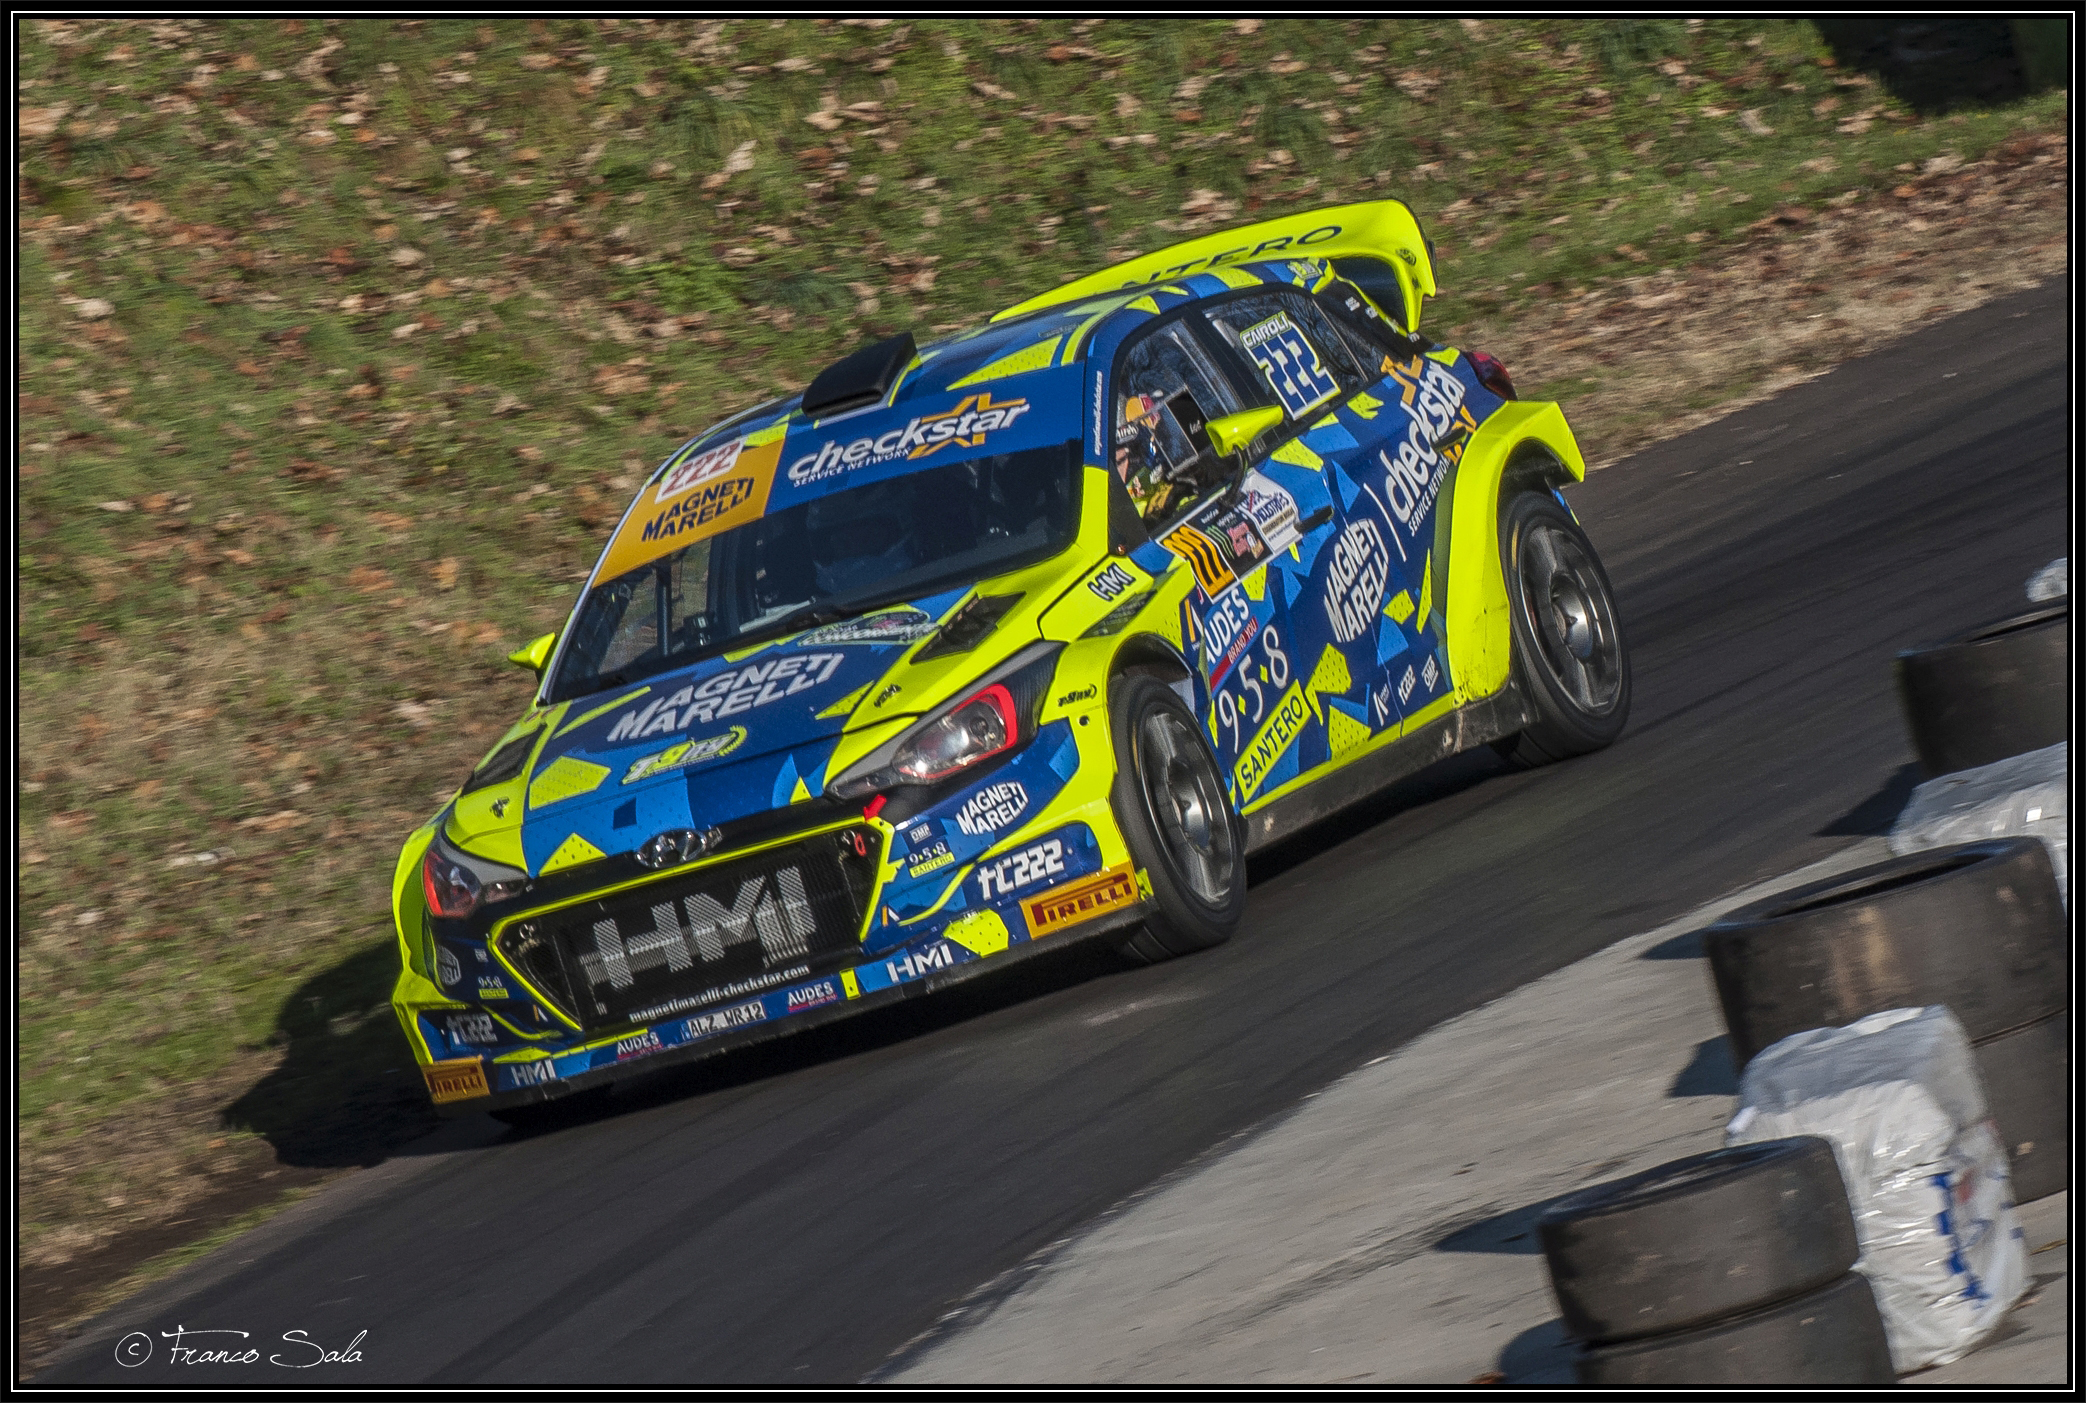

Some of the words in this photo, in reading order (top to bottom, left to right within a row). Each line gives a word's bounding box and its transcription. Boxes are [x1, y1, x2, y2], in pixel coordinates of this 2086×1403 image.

[1242, 315, 1289, 348] CAIROLI
[1249, 323, 1339, 417] 222
[661, 440, 741, 498] 222
[787, 403, 1030, 481] checkstar
[1380, 360, 1466, 524] checkstar
[642, 478, 755, 528] MAGNETI
[793, 464, 844, 488] SERVICE
[641, 488, 753, 542] MARELLI
[1408, 491, 1432, 537] SERVICE
[1087, 562, 1136, 602] HMI
[1162, 526, 1236, 597] 222
[1325, 518, 1389, 618] MAGNETI
[1324, 550, 1389, 643] MARELLI
[1205, 588, 1249, 665] AUDES
[1226, 632, 1248, 664] BRAND
[1244, 616, 1259, 641] YOU
[607, 672, 842, 742] MARELLI
[612, 653, 845, 722] MAGNETI
[1241, 695, 1303, 789] SANTERO
[956, 782, 1028, 829] MAGNETI
[957, 793, 1028, 836] MARELLI
[1030, 873, 1132, 928] PIRELLI
[580, 866, 817, 990] HMI
[886, 944, 954, 984] HMI
[690, 1014, 719, 1038] ALZ
[722, 1002, 765, 1028] WR12
[787, 981, 834, 1007] AUDES
[617, 1031, 660, 1056] AUDES
[510, 1058, 557, 1087] HMI
